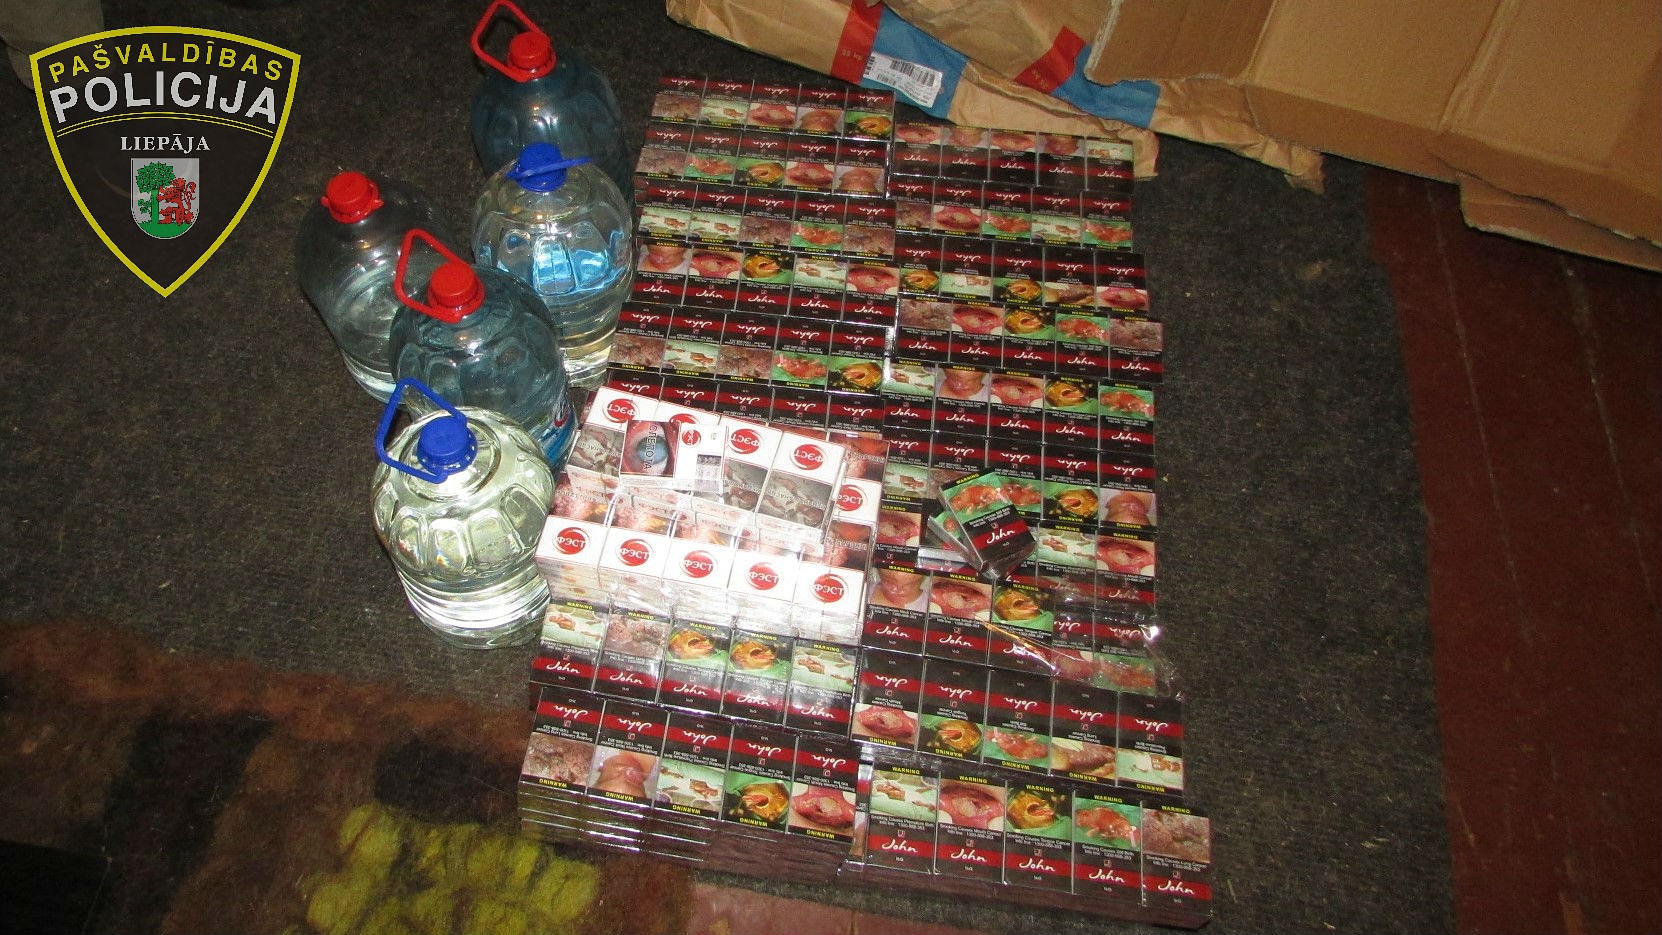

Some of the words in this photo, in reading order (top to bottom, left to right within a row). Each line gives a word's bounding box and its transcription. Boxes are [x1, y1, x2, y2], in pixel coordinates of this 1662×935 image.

[643, 285, 670, 294] John
[696, 290, 723, 299] John
[748, 295, 776, 304] John
[801, 299, 830, 309] John
[854, 306, 883, 315] John
[632, 313, 660, 322] John
[684, 319, 712, 328] John
[737, 324, 765, 334] John
[792, 330, 820, 339] John
[844, 335, 874, 344] John
[909, 341, 936, 351] John
[962, 346, 990, 355] John
[1014, 352, 1042, 360] John
[1067, 357, 1096, 366] John
[1121, 362, 1151, 371] John
[621, 382, 649, 392] John
[675, 389, 704, 399] John
[730, 395, 760, 405] John
[608, 403, 637, 417] ФЭСТ
[786, 401, 816, 411] John
[843, 406, 872, 416] John
[890, 408, 919, 418] John
[945, 413, 975, 423] John
[1001, 420, 1030, 429] John
[1056, 426, 1085, 436] John
[730, 433, 760, 447] ФЭСТ
[1111, 432, 1141, 442] John
[890, 439, 919, 449] John
[793, 448, 823, 462] ФЭСТ
[945, 446, 975, 457] John
[1001, 452, 1031, 463] John
[1058, 459, 1087, 470] John
[1113, 466, 1143, 476] John
[955, 473, 980, 484] WARNING
[987, 529, 1016, 544] John
[557, 535, 586, 549] ФЭСТ
[619, 547, 650, 560] ФЭСТ
[684, 559, 714, 572] ФЭСТ
[748, 572, 779, 584] ФЭСТ
[950, 573, 976, 582] WARNING
[813, 583, 844, 596] ФЭСТ
[566, 601, 593, 610] WARNING
[628, 611, 655, 620] WARNING
[690, 622, 717, 631] WARNING
[750, 632, 778, 641] WARNING
[876, 625, 911, 639] John
[939, 634, 974, 647] John
[813, 644, 840, 652] WARNING
[546, 661, 580, 674] John
[610, 672, 643, 685] John
[874, 675, 908, 689] John
[673, 684, 708, 696] John
[938, 685, 973, 700] John
[736, 694, 771, 707] John
[1003, 697, 1038, 711] John
[553, 704, 589, 720] John
[800, 706, 836, 719] John
[1068, 708, 1103, 722] John
[617, 718, 653, 733] John
[1134, 718, 1169, 732] John
[682, 730, 718, 745] John
[869, 737, 897, 746] WARNING
[746, 742, 782, 758] John
[935, 748, 963, 758] WARNING
[812, 754, 847, 769] John
[1002, 760, 1030, 770] WARNING
[891, 766, 920, 776] WARNING
[959, 775, 988, 785] WARNING
[1069, 773, 1098, 782] WARNING
[539, 779, 568, 789] WARNING
[1025, 784, 1055, 793] WARNING
[1136, 783, 1165, 793] WARNING
[606, 791, 634, 801] WARNING
[1094, 794, 1123, 804] WARNING
[672, 804, 701, 814] WARNING
[1161, 805, 1191, 815] WARNING
[739, 817, 768, 828] WARNING
[807, 829, 835, 839] WARNING
[881, 838, 919, 854] John
[950, 848, 988, 863] John
[1018, 857, 1056, 872] John
[1088, 868, 1126, 884] John
[1157, 879, 1196, 895] John
